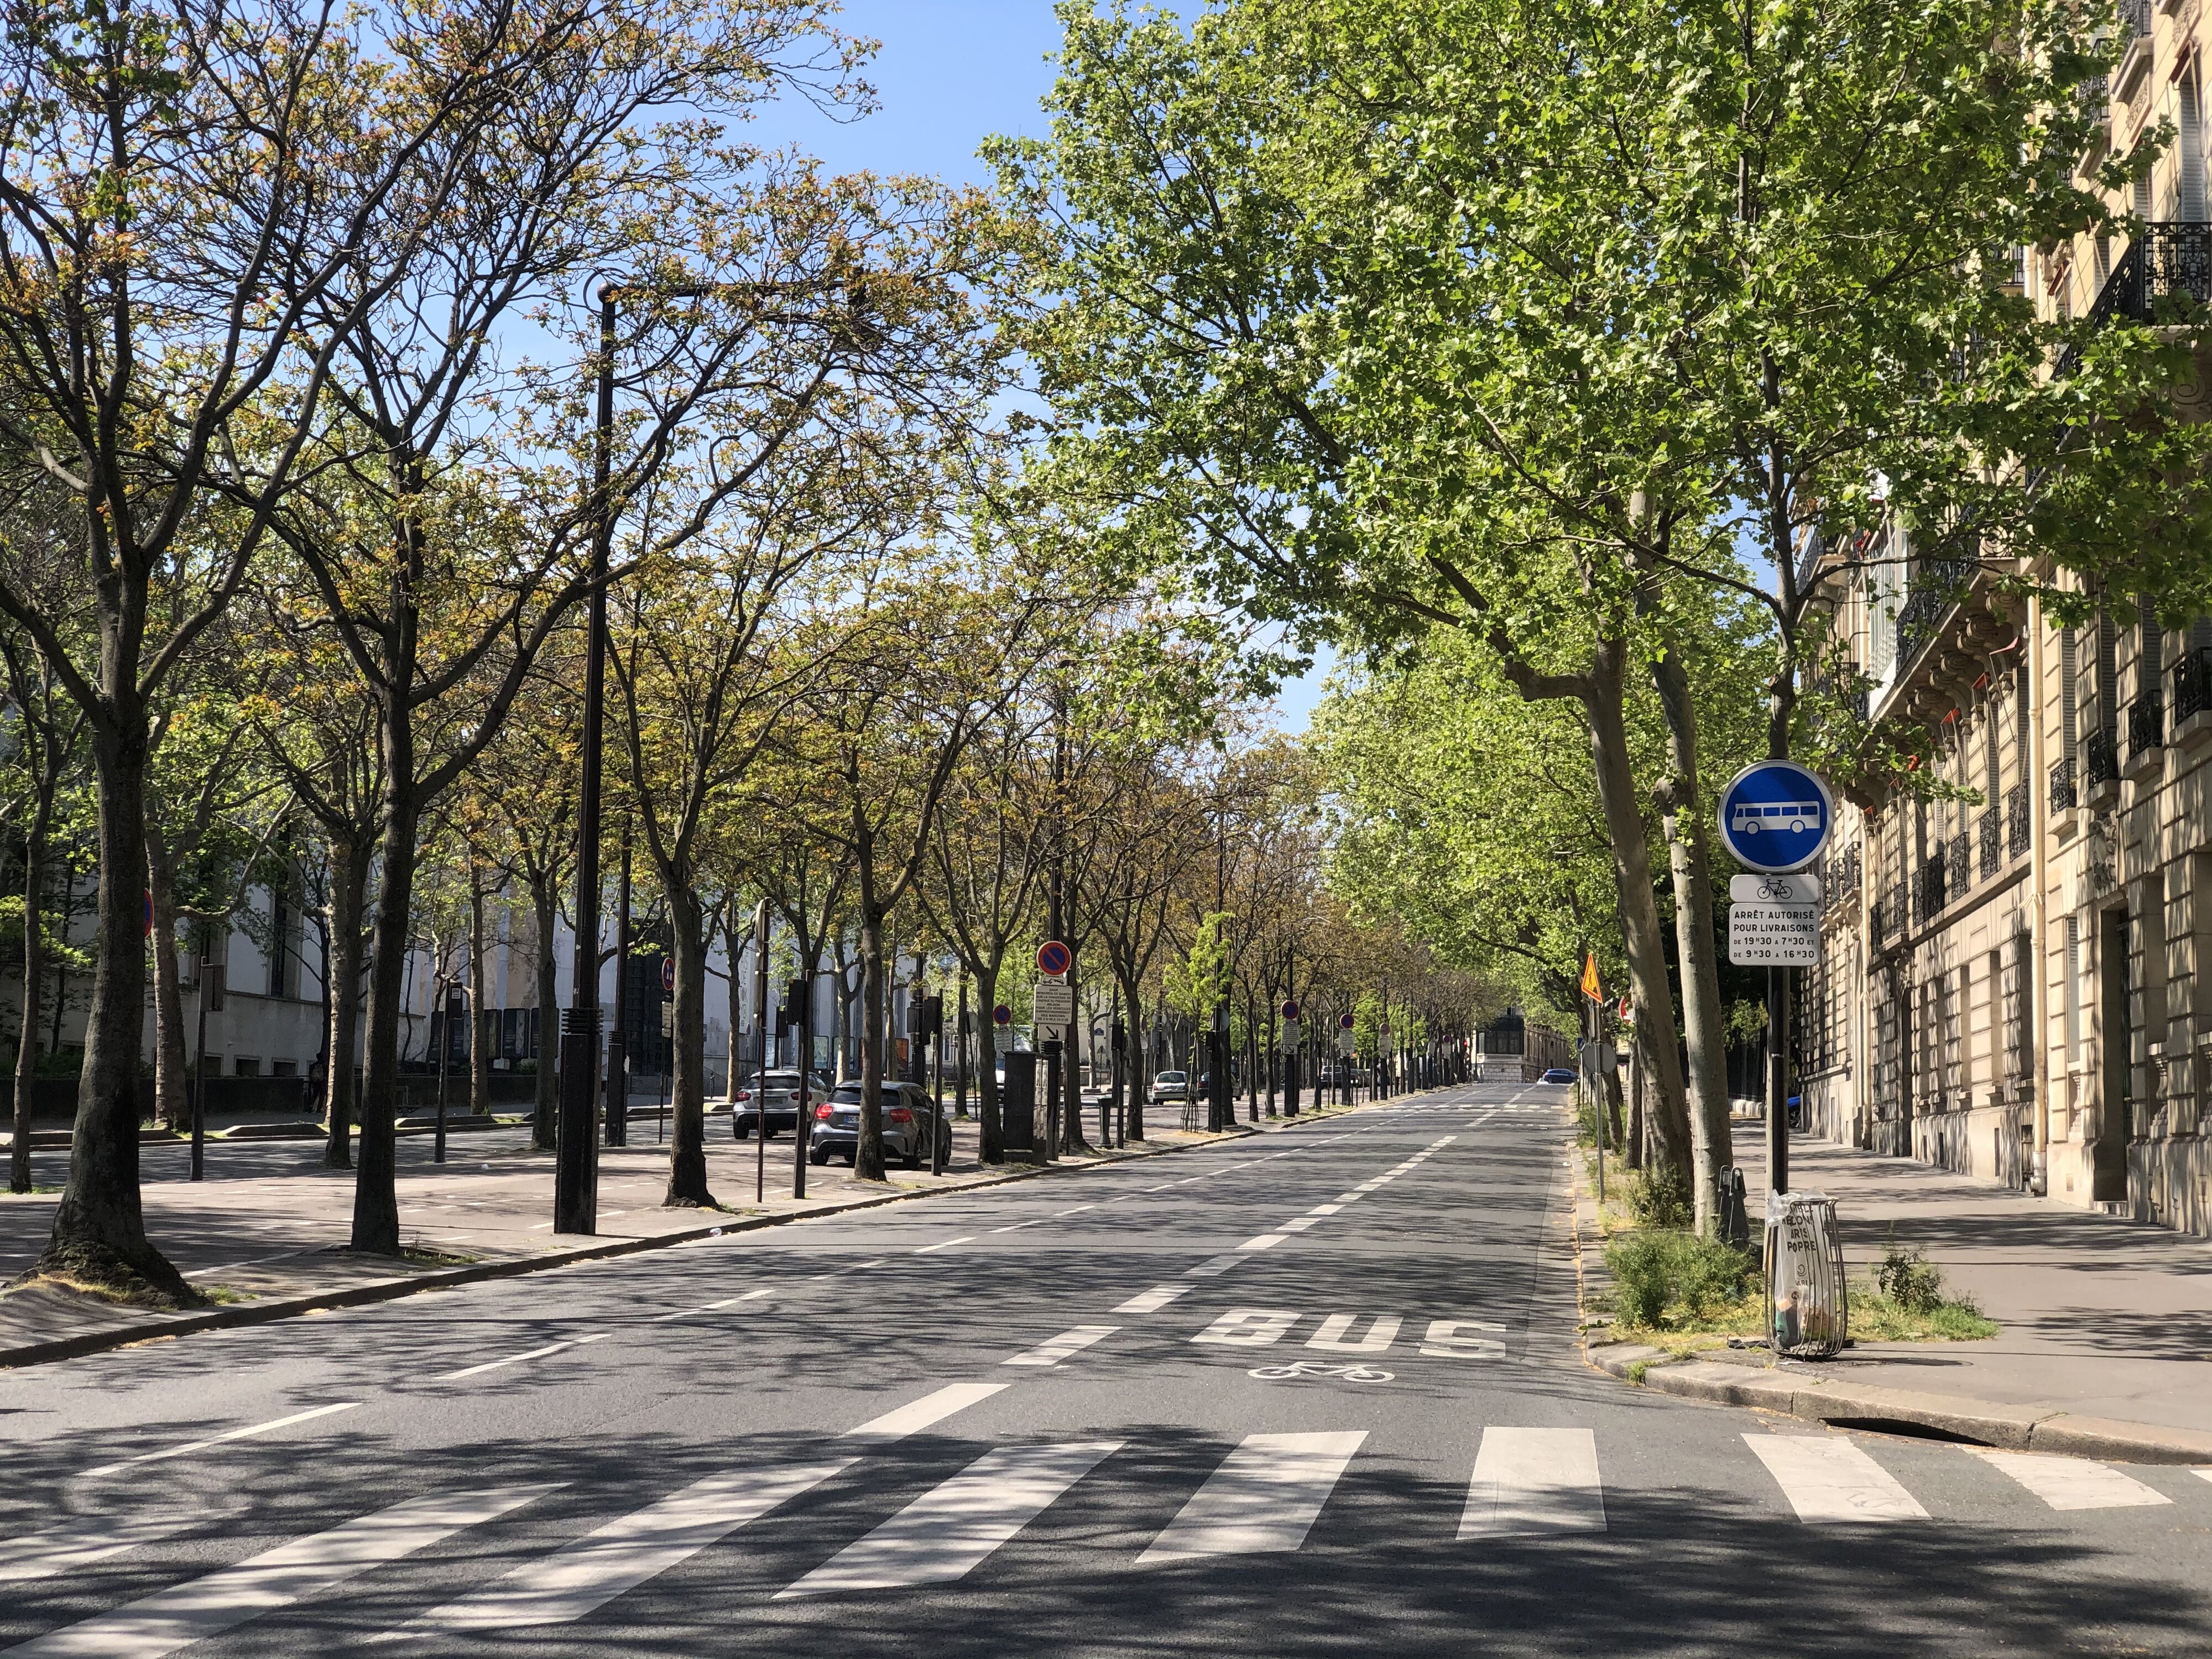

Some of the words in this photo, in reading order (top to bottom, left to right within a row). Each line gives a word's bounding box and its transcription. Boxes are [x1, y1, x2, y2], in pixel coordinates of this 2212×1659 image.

[1734, 910, 1765, 919] ARRÊT
[1768, 910, 1814, 919] AUTORISÉ
[1189, 1309, 1506, 1359] BUS
